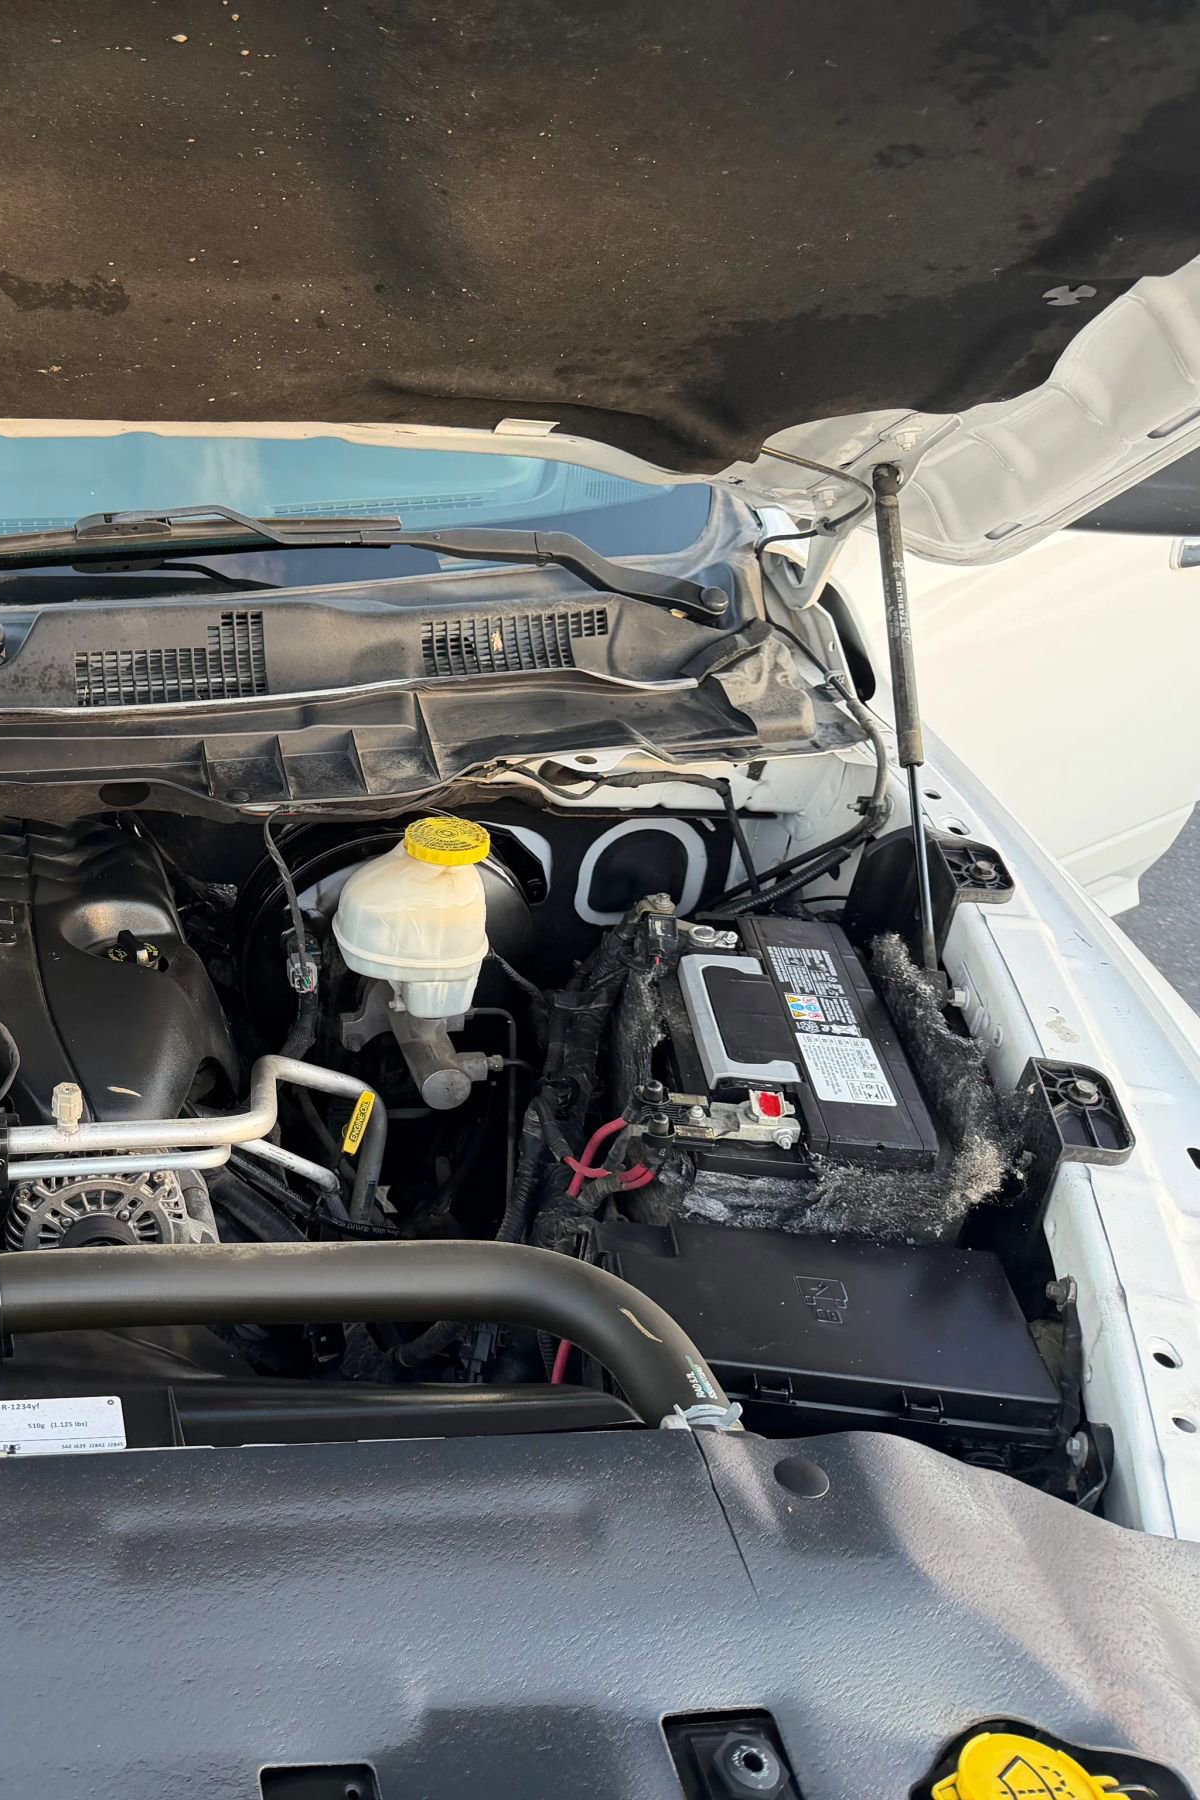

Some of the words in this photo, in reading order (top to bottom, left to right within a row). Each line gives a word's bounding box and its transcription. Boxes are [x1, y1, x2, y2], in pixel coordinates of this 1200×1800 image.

[896, 581, 906, 628] STABILUS
[350, 1114, 366, 1141] ENGINE
[361, 1102, 370, 1113] OIL
[692, 1384, 706, 1398] RAD
[1, 1403, 40, 1412] R-1234yf
[27, 1422, 45, 1430] 510g
[50, 1421, 73, 1429] (1.125
[74, 1420, 88, 1428] lbs)
